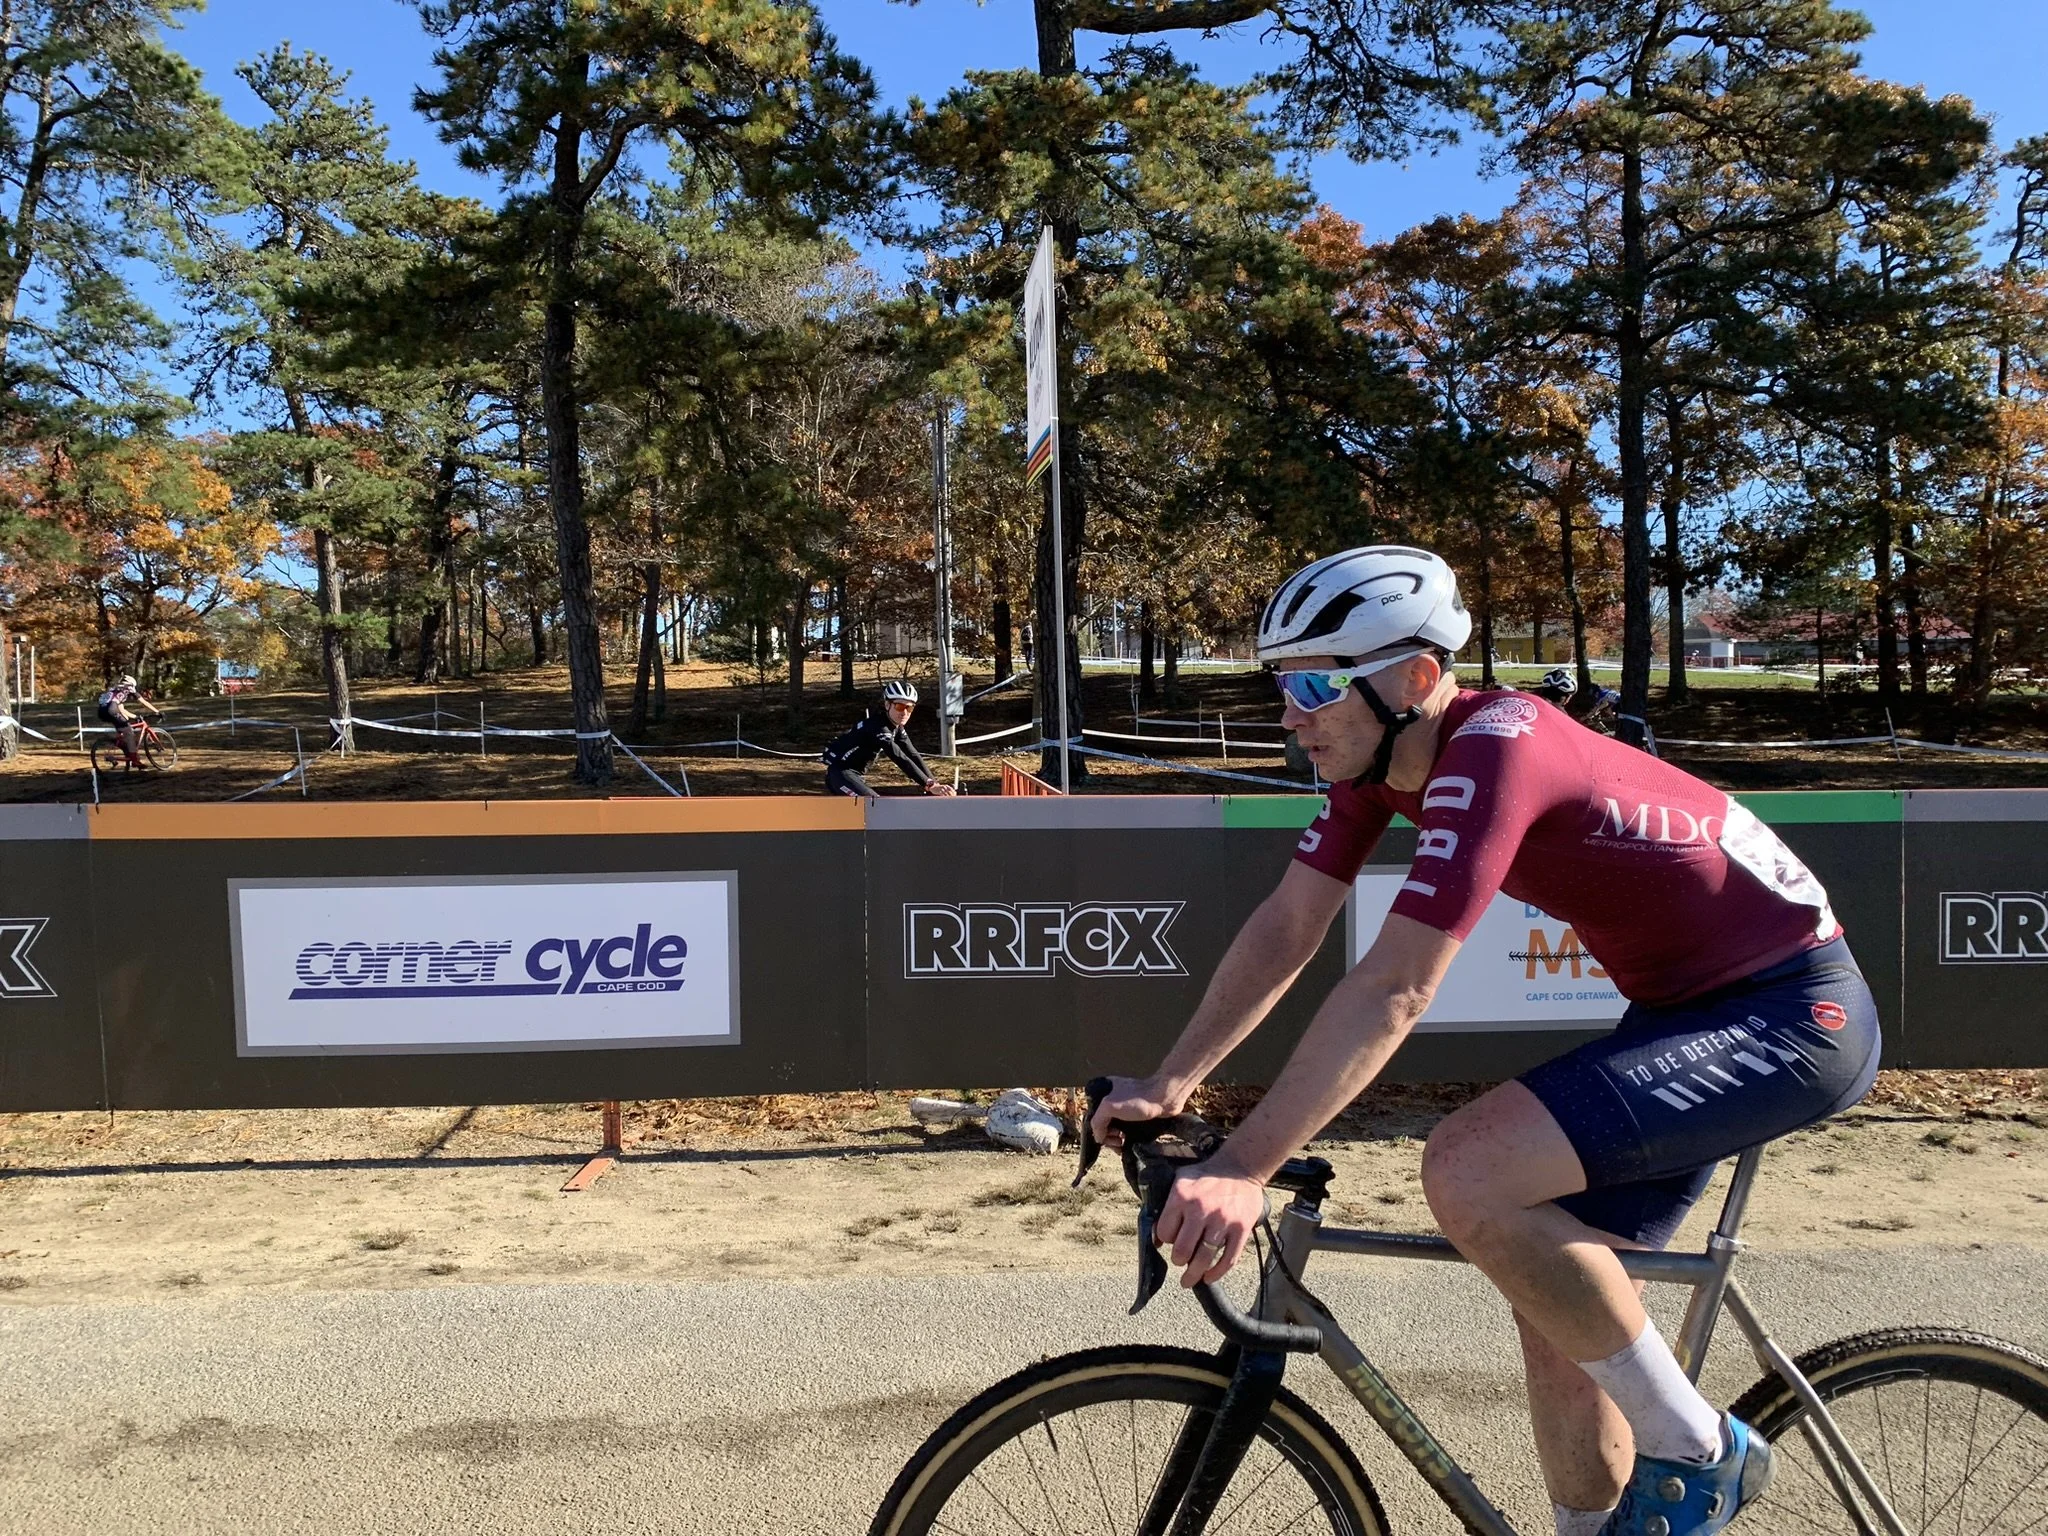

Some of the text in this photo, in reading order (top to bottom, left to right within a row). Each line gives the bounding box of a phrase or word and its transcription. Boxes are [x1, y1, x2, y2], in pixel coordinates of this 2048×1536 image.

[1582, 838, 1674, 853] METROPOLITAN
[903, 901, 1189, 979] RRFCX
[295, 923, 688, 995] corner cycle
[597, 981, 666, 993] CAPE COD
[1526, 991, 1620, 1001] CAPE COD GETAWAY
[1626, 1065, 1653, 1087] TO
[1654, 1052, 1682, 1074] BE
